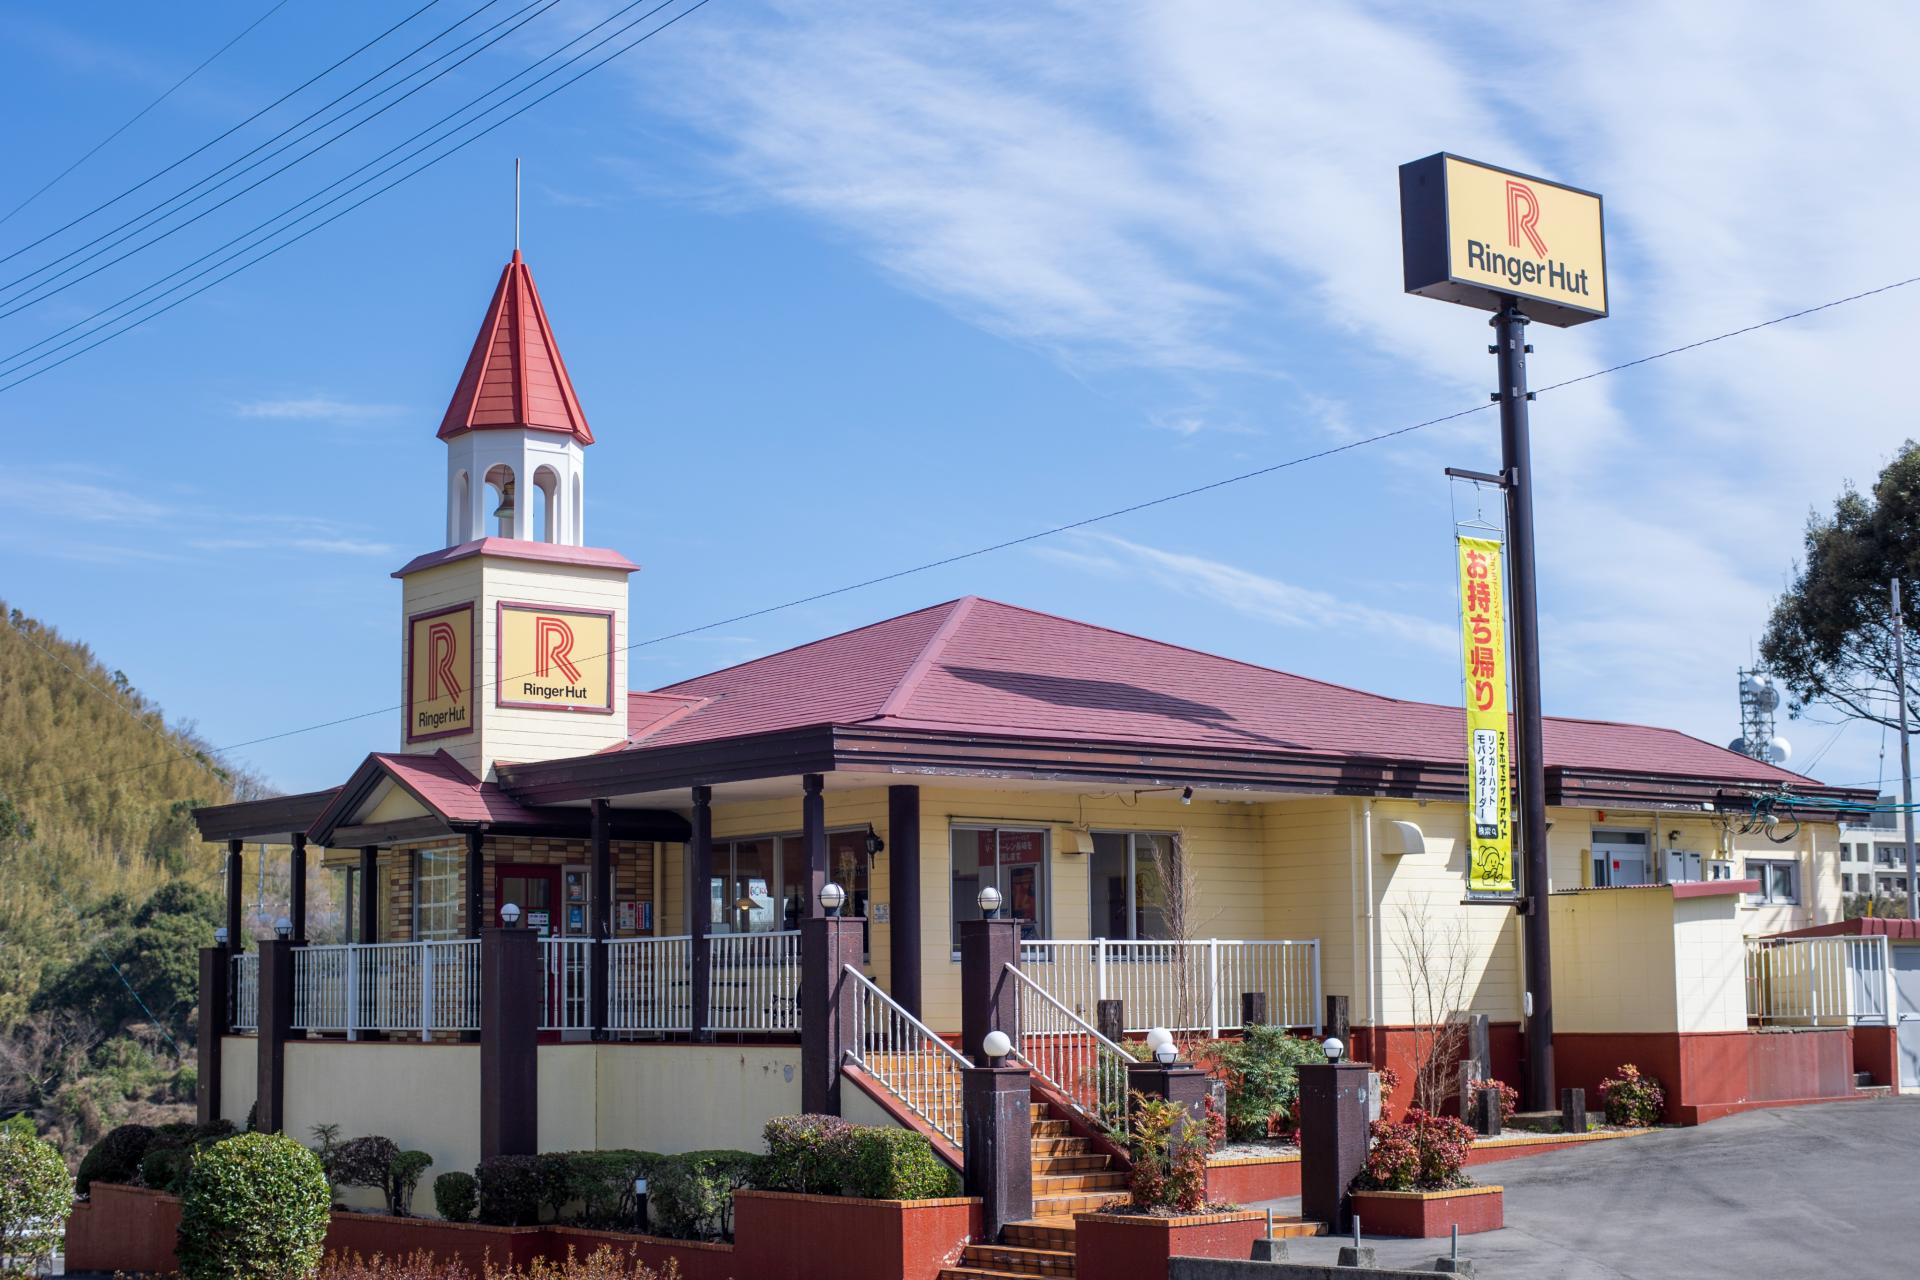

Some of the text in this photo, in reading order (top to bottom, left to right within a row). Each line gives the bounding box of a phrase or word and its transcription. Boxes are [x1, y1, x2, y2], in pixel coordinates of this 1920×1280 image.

[1505, 179, 1549, 260] R
[1467, 239, 1589, 296] Ringer Hut
[428, 622, 462, 705] R
[535, 616, 582, 686] R
[1466, 549, 1495, 712] お持ち帰り
[418, 705, 466, 729] Ringer Hut
[523, 683, 588, 700] Ringer Hut
[1477, 734, 1488, 819] モバイルオーダー
[1488, 734, 1496, 806] リンガーハット
[1499, 731, 1508, 840] スマホでテイクアウト
[1478, 826, 1491, 836] 検索
